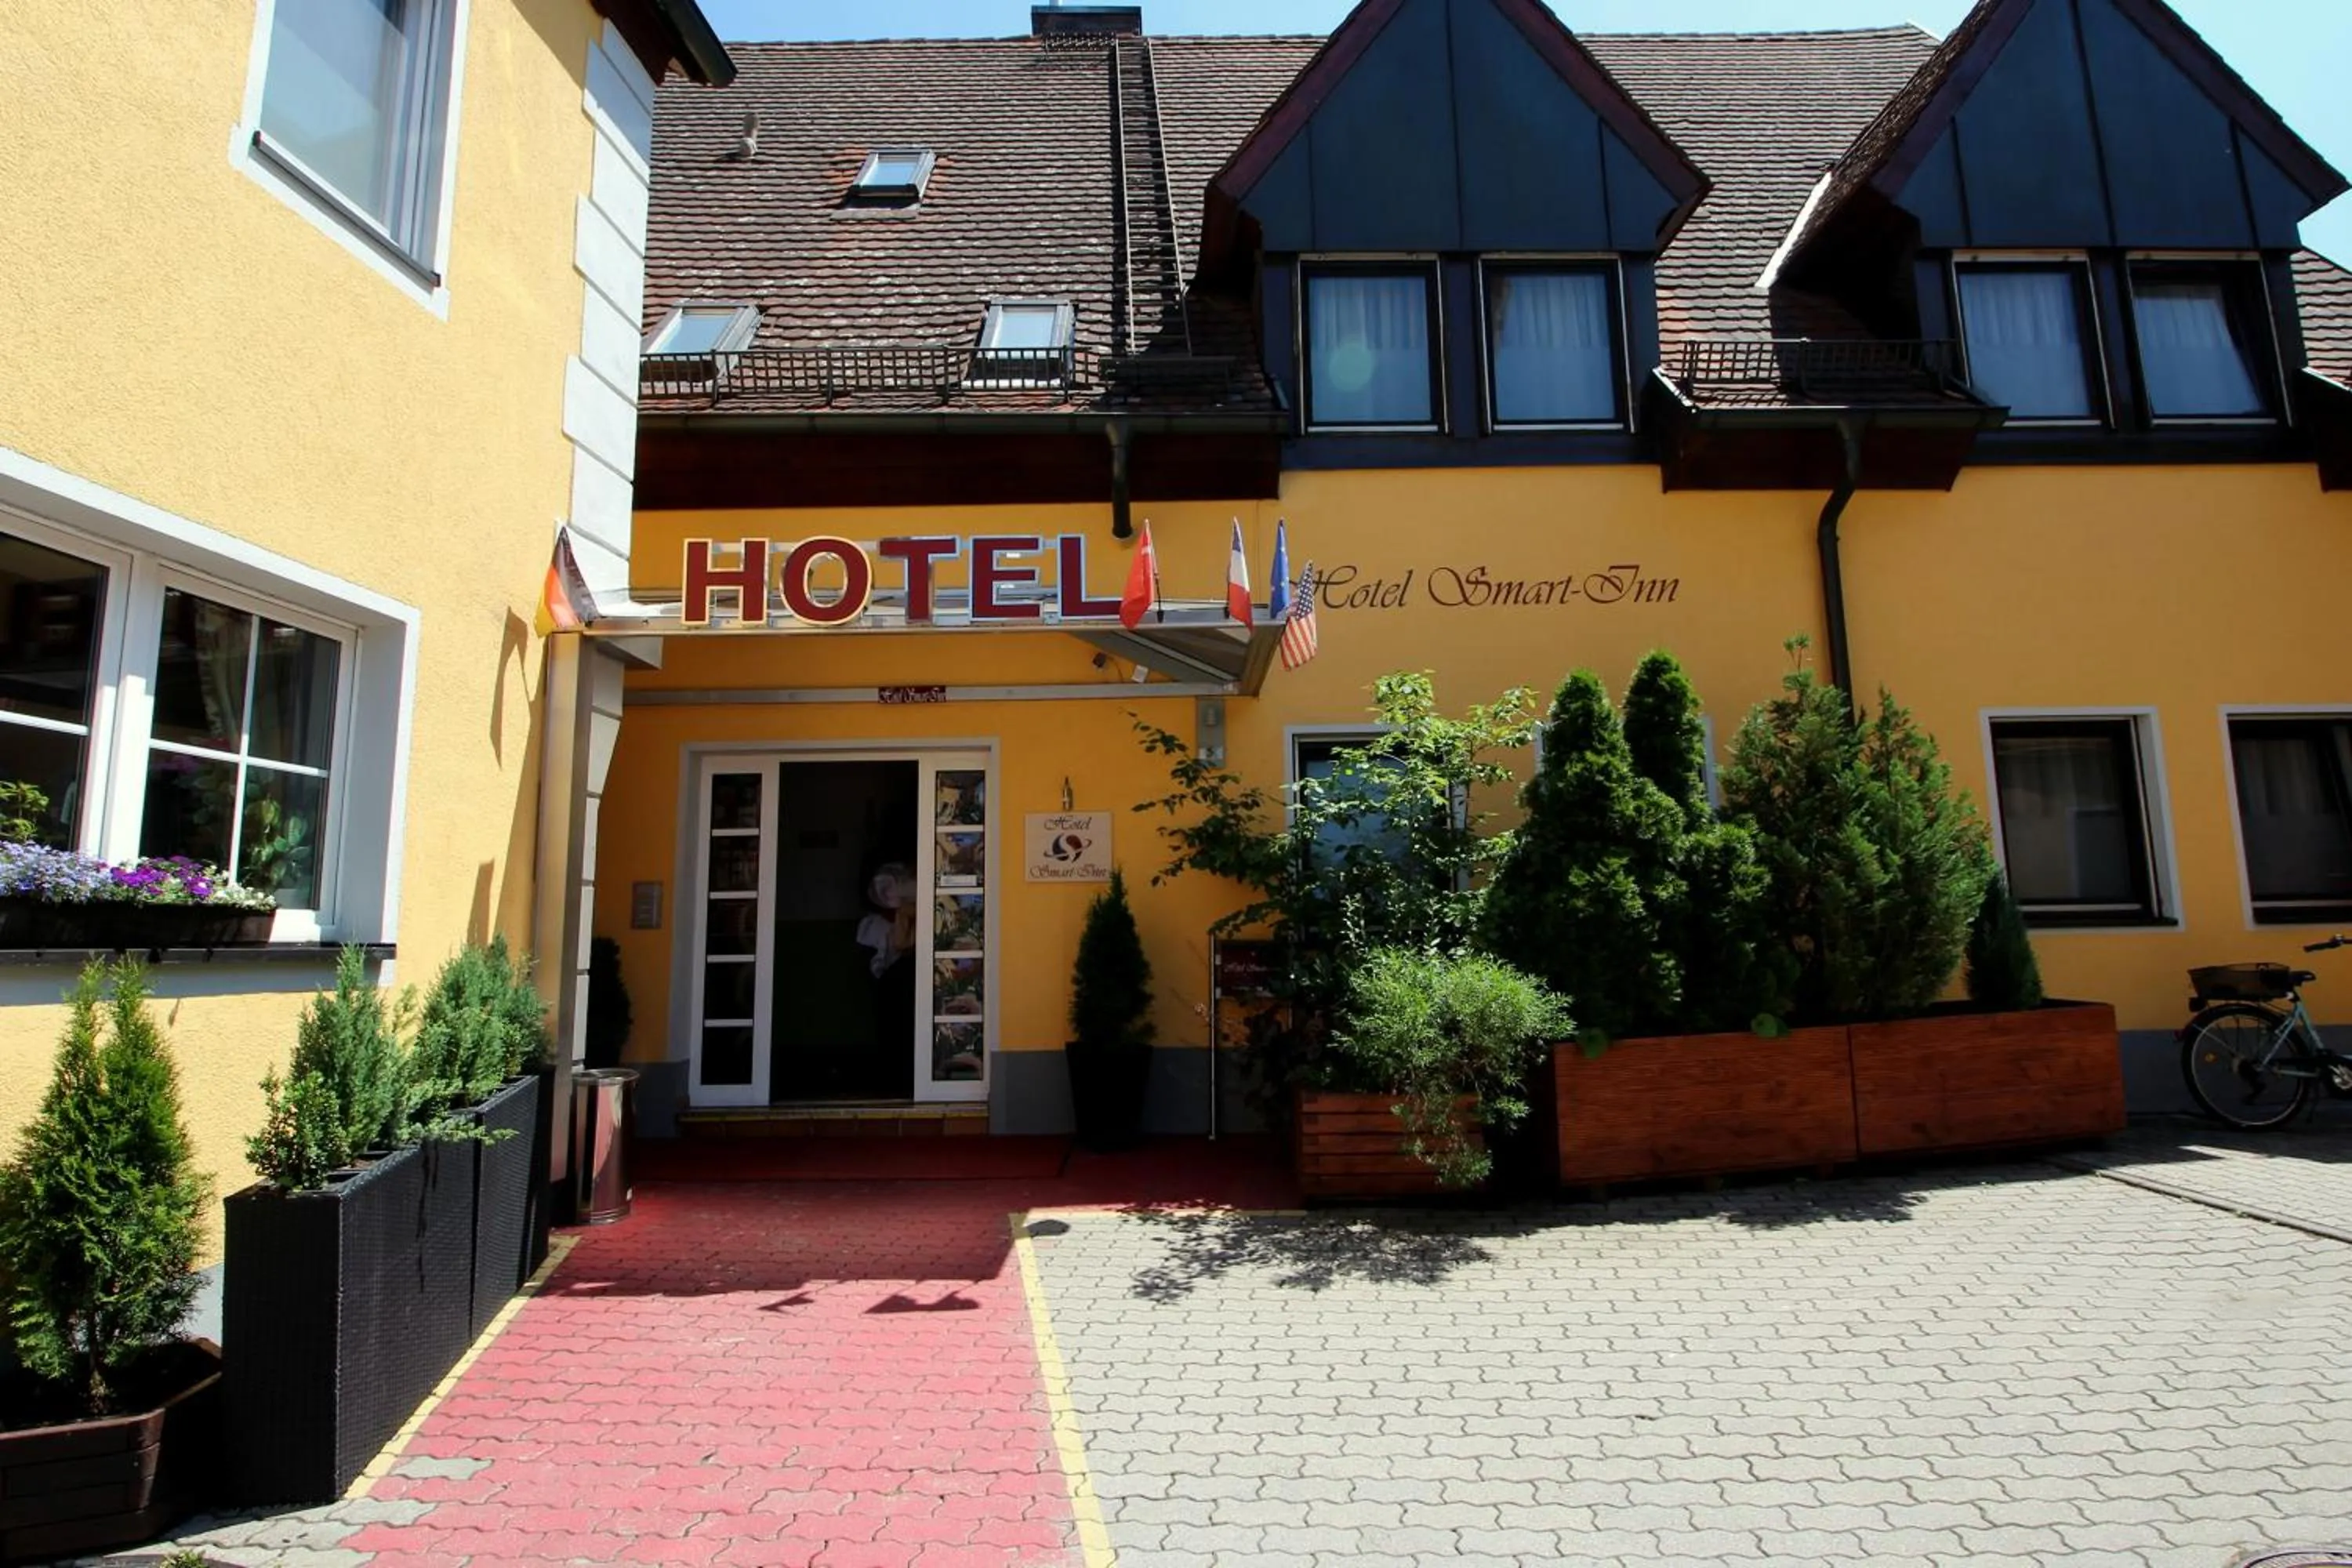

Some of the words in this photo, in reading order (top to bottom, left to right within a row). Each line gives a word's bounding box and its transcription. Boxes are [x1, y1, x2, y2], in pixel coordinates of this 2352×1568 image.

[682, 535, 1123, 625] HOTEL
[1289, 565, 1414, 609] Hotel
[1428, 565, 1680, 607] Smart-Inn
[1044, 815, 1092, 831] Hotel
